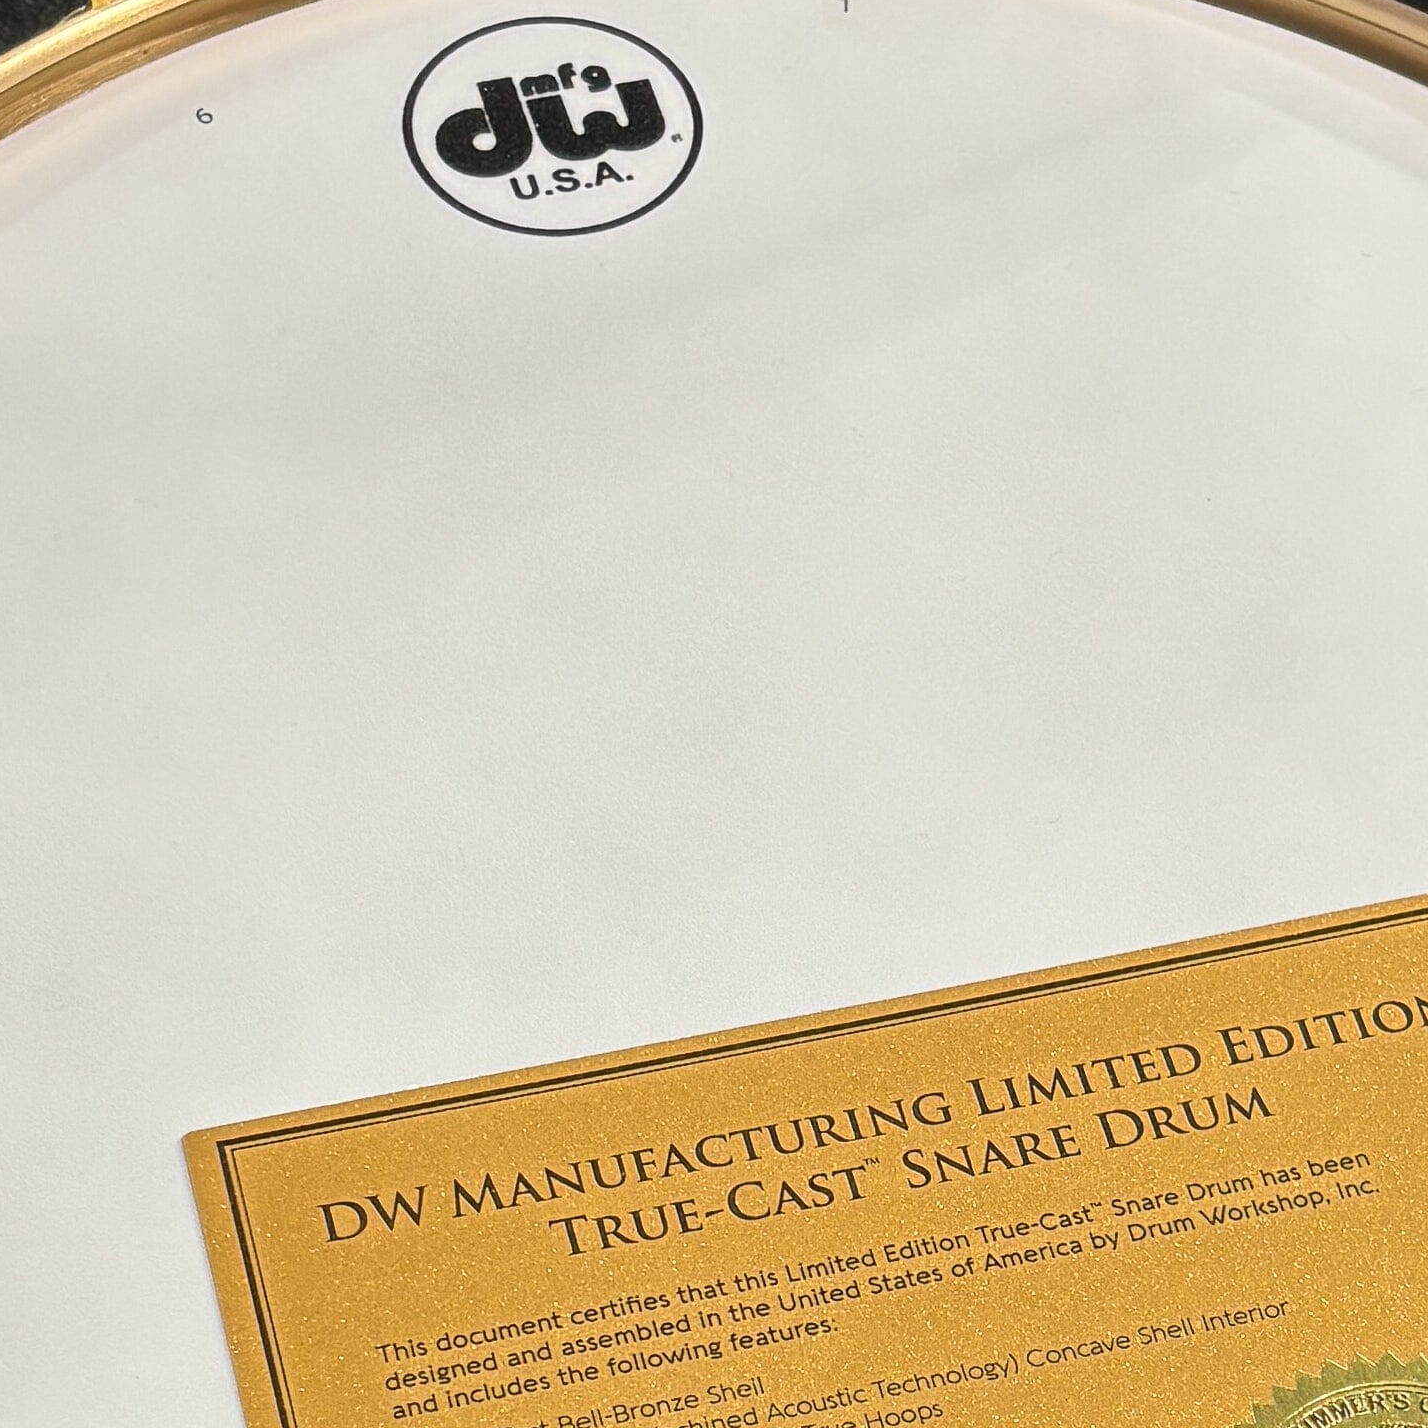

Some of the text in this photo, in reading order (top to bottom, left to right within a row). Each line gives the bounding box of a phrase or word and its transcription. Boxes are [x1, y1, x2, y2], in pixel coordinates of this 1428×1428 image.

[519, 62, 613, 98] mfg
[509, 160, 635, 200] U.S.A.
[316, 1183, 428, 1243] DW
[451, 1091, 952, 1218] MANUFACTURING
[965, 1043, 1202, 1116] LIMITED
[901, 1123, 1082, 1189] SNARE
[1092, 1086, 1275, 1150] DRUM
[373, 1338, 428, 1363] This
[435, 1310, 563, 1351] document
[569, 1293, 671, 1325] certifies
[675, 1278, 729, 1304] that
[732, 1269, 779, 1293] this
[783, 1247, 877, 1282] Limited
[882, 1233, 971, 1263] Edition
[1110, 1191, 1179, 1217] Snare
[1185, 1176, 1254, 1201] Drum
[1258, 1166, 1302, 1187] has
[1305, 1152, 1371, 1177] been
[384, 1179, 1380, 1391] designed and assembled in the United States of America by Drum Workshop, Inc.
[392, 1317, 838, 1419] and includes the following features:
[767, 1386, 868, 1422] Acoustic
[869, 1352, 1019, 1399] Technology)
[1025, 1334, 1131, 1367] Concave
[1136, 1316, 1195, 1345] Shell
[1200, 1300, 1289, 1331] Interior
